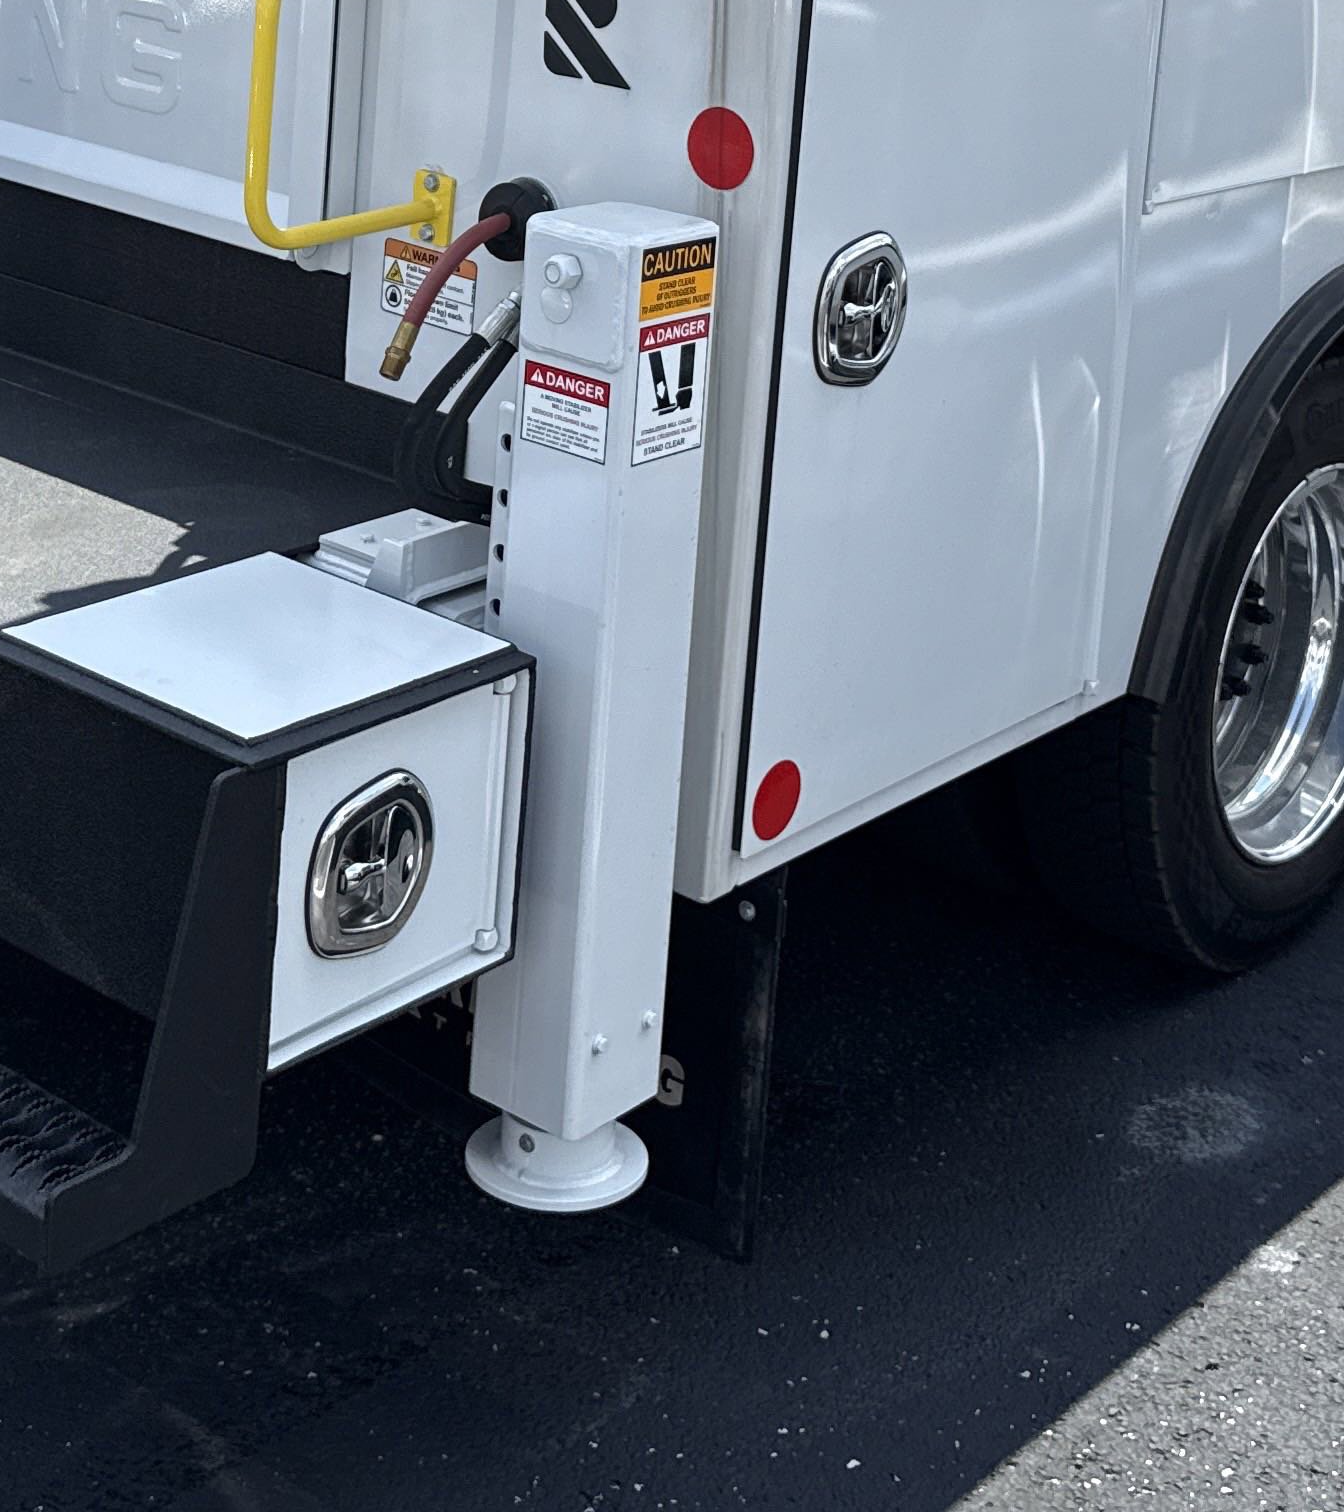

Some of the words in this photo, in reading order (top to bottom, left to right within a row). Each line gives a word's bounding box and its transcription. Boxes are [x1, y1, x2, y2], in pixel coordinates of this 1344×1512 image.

[644, 242, 712, 276] CAUTION
[656, 319, 705, 343] DANGER
[545, 371, 605, 402] DANGER
[664, 438, 685, 450] CLEAR
